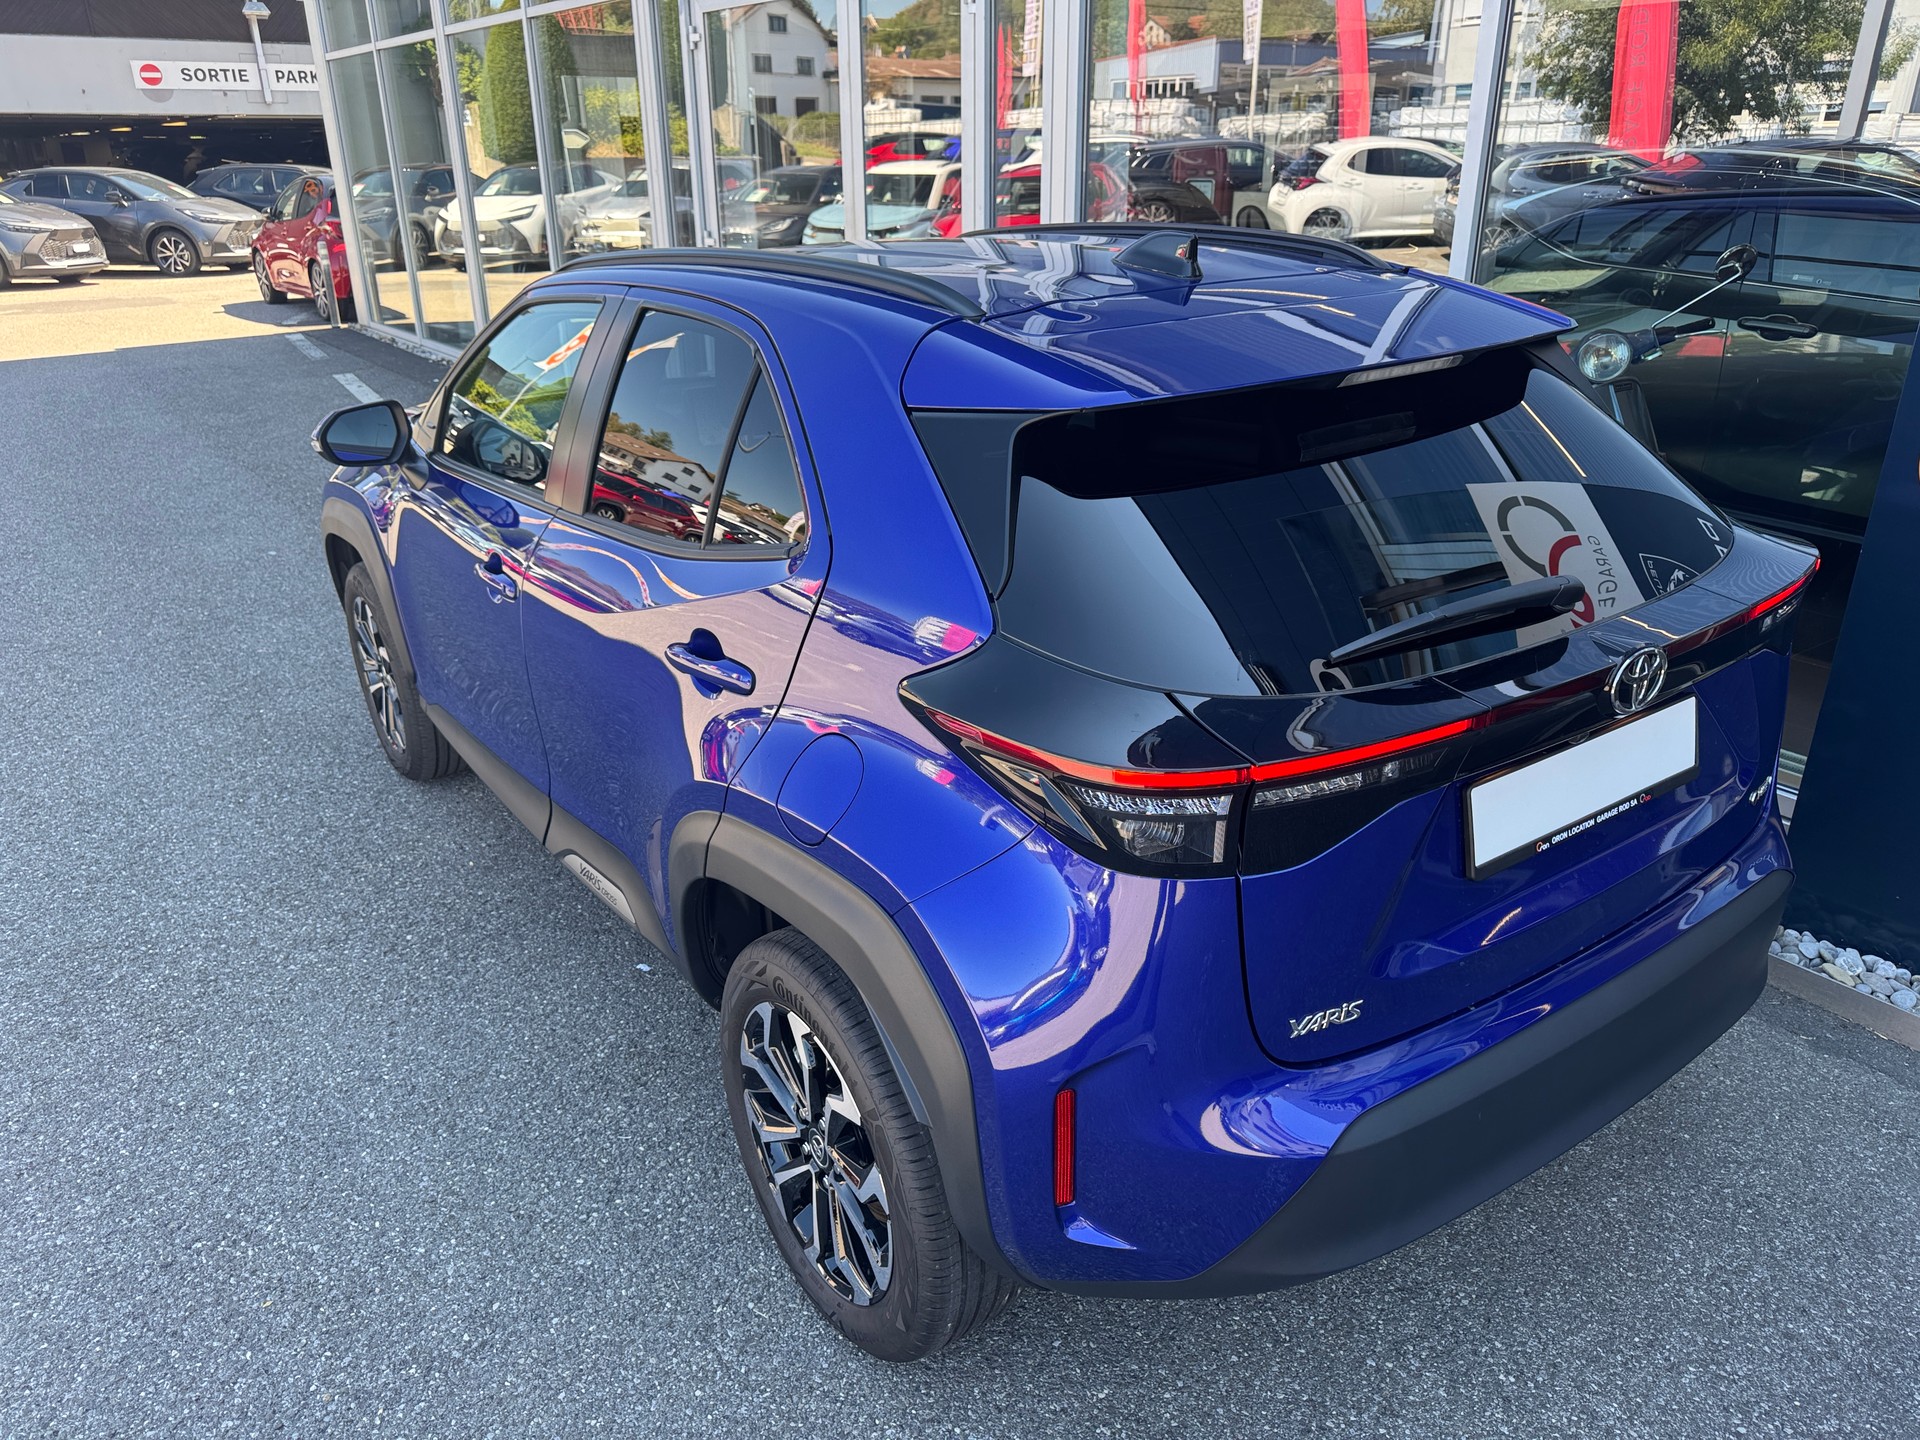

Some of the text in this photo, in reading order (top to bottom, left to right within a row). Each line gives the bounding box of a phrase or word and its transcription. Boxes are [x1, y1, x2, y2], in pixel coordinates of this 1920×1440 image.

[180, 67, 249, 83] SORTIE
[1552, 832, 1567, 844] ORON
[1569, 819, 1594, 836] LOCATION
[1597, 807, 1618, 823] GARAGE
[1619, 802, 1629, 812] ROD
[1631, 799, 1637, 807] SA
[772, 975, 850, 1075] Continental
